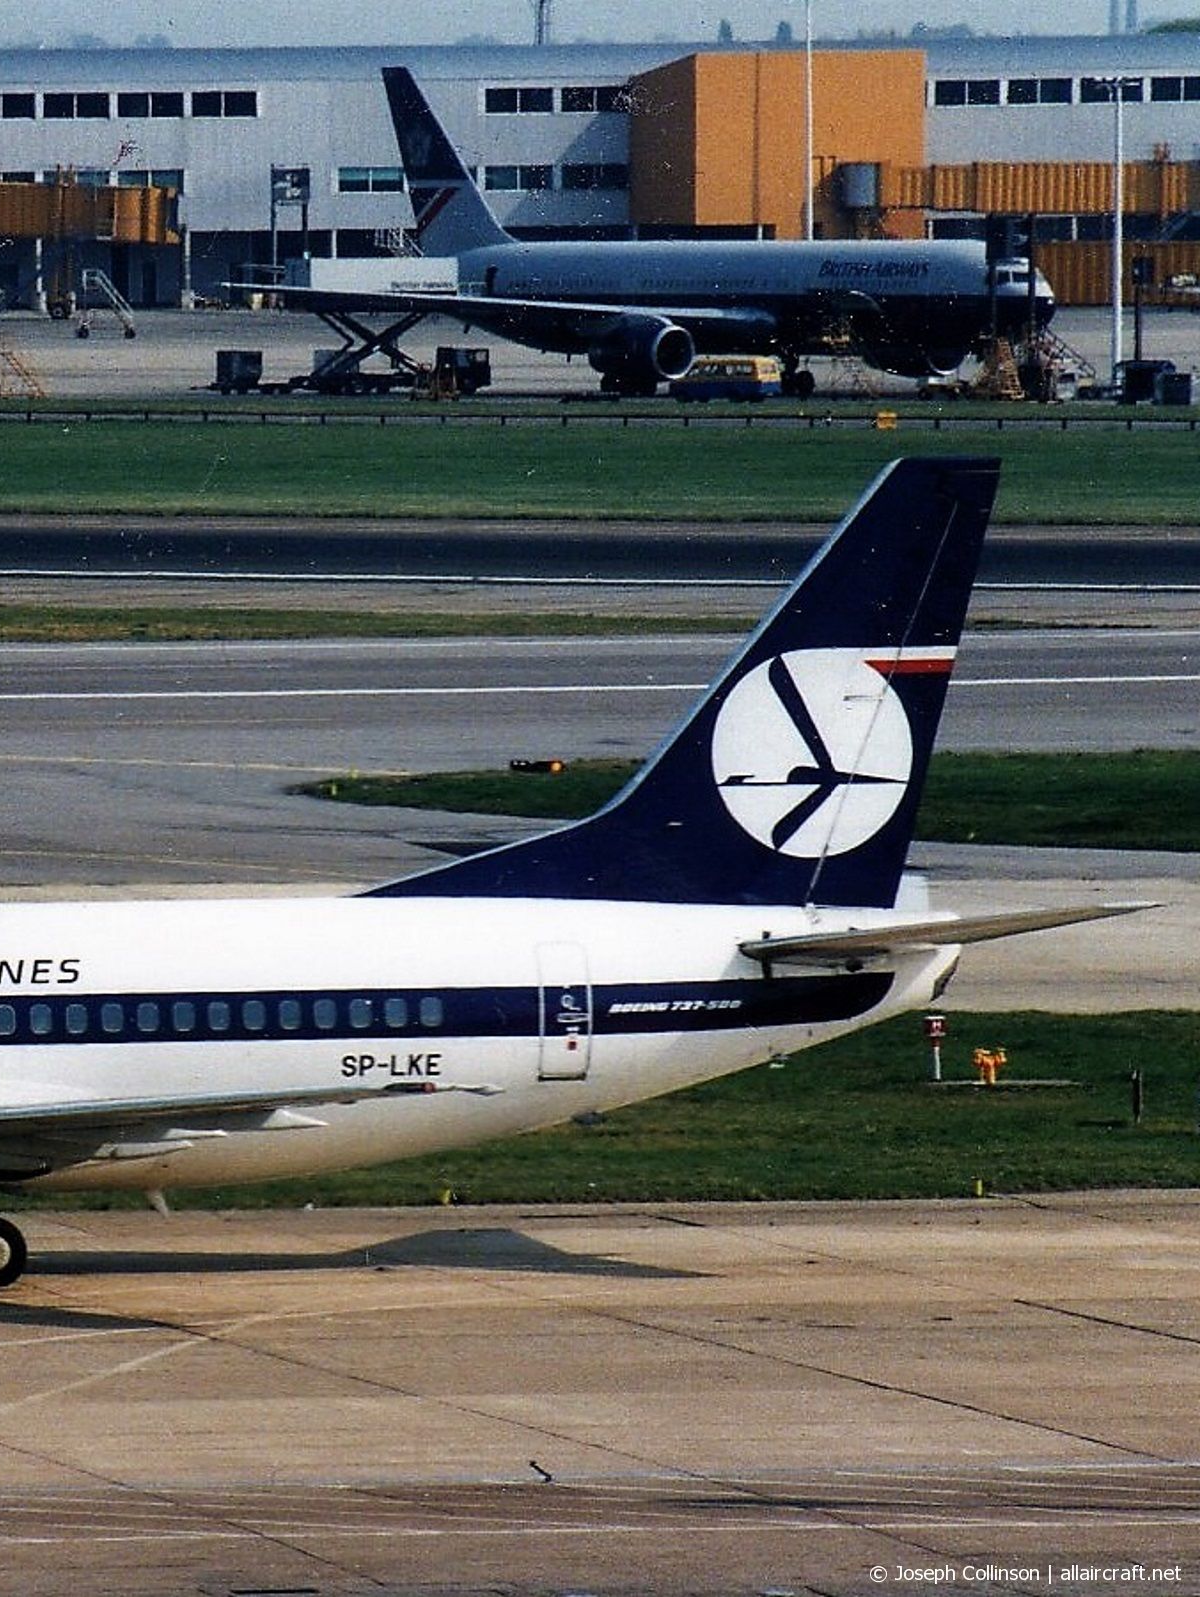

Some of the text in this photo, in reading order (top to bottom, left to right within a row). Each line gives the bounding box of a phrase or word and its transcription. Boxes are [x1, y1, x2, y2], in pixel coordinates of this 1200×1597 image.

[608, 999, 742, 1014] BOEING 737-500
[341, 1053, 442, 1078] SP-LKE
